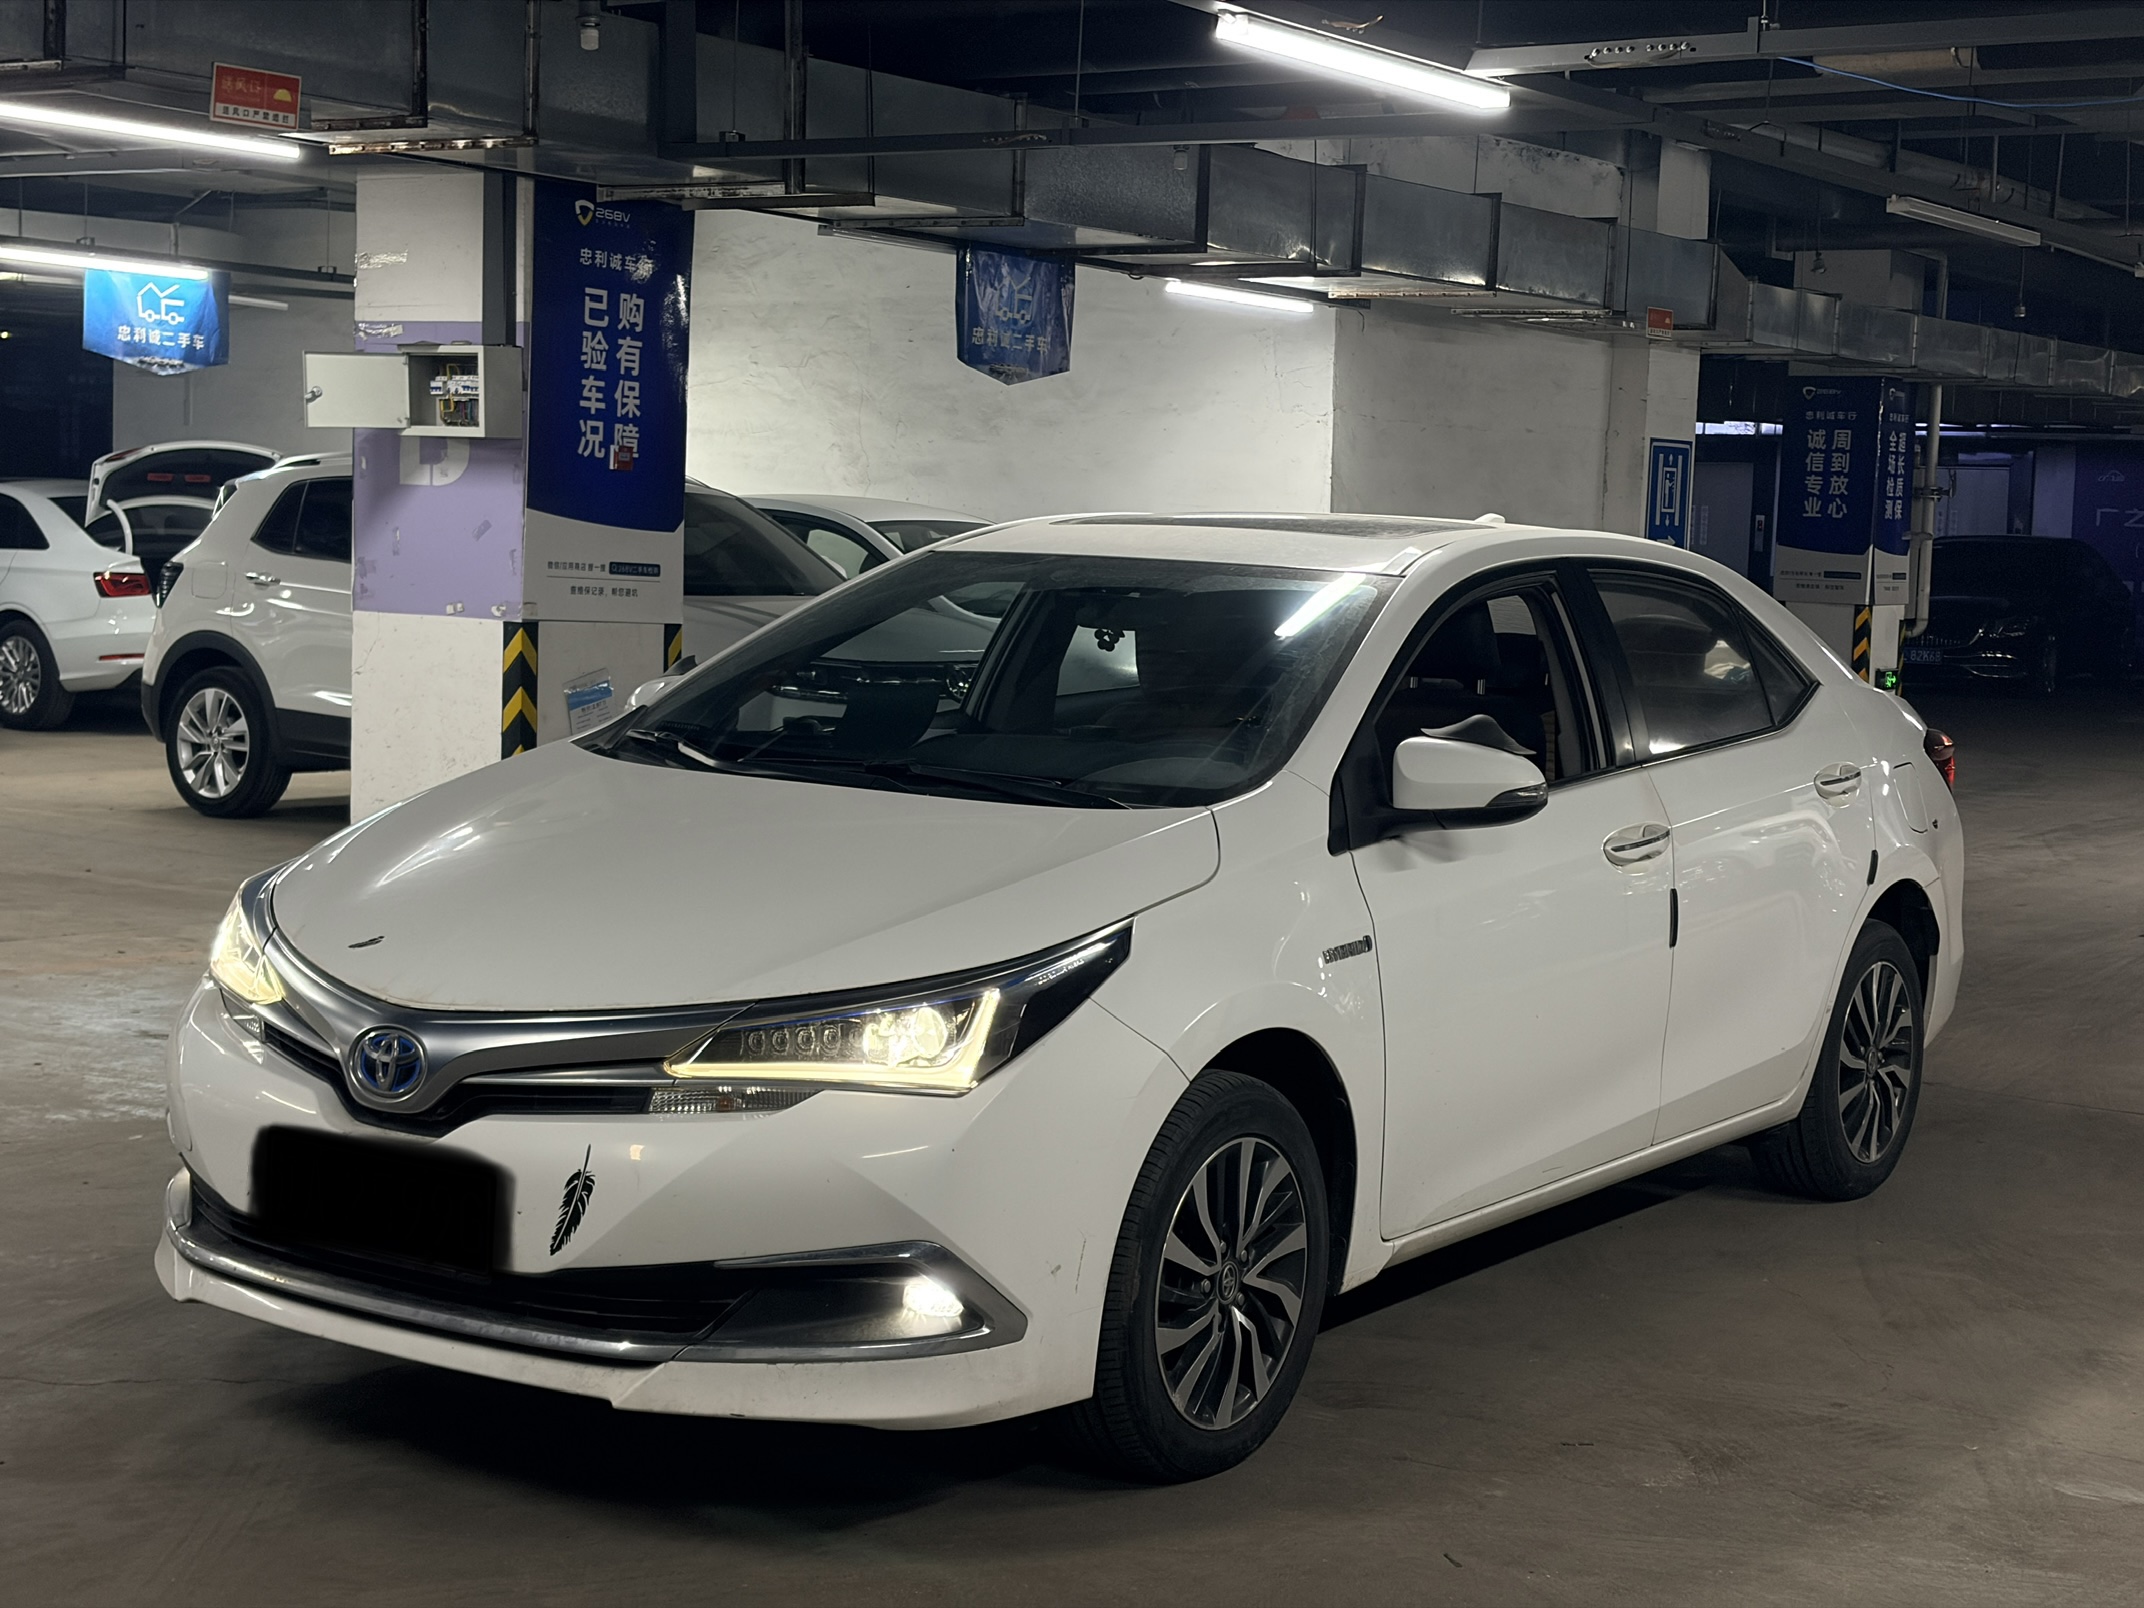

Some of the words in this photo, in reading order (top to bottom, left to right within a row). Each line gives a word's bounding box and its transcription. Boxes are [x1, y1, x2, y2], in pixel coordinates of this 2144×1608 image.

[595, 207, 631, 223] 268V
[117, 325, 205, 350] 忠利诚二手车
[971, 327, 1049, 354] 忠利诚二手车
[577, 287, 609, 459] 已验车况
[614, 293, 645, 459] 购有保障
[1805, 410, 1858, 421] 忠利诚车行
[1802, 429, 1827, 518] 诚信专业
[1827, 429, 1852, 519] 周到放心
